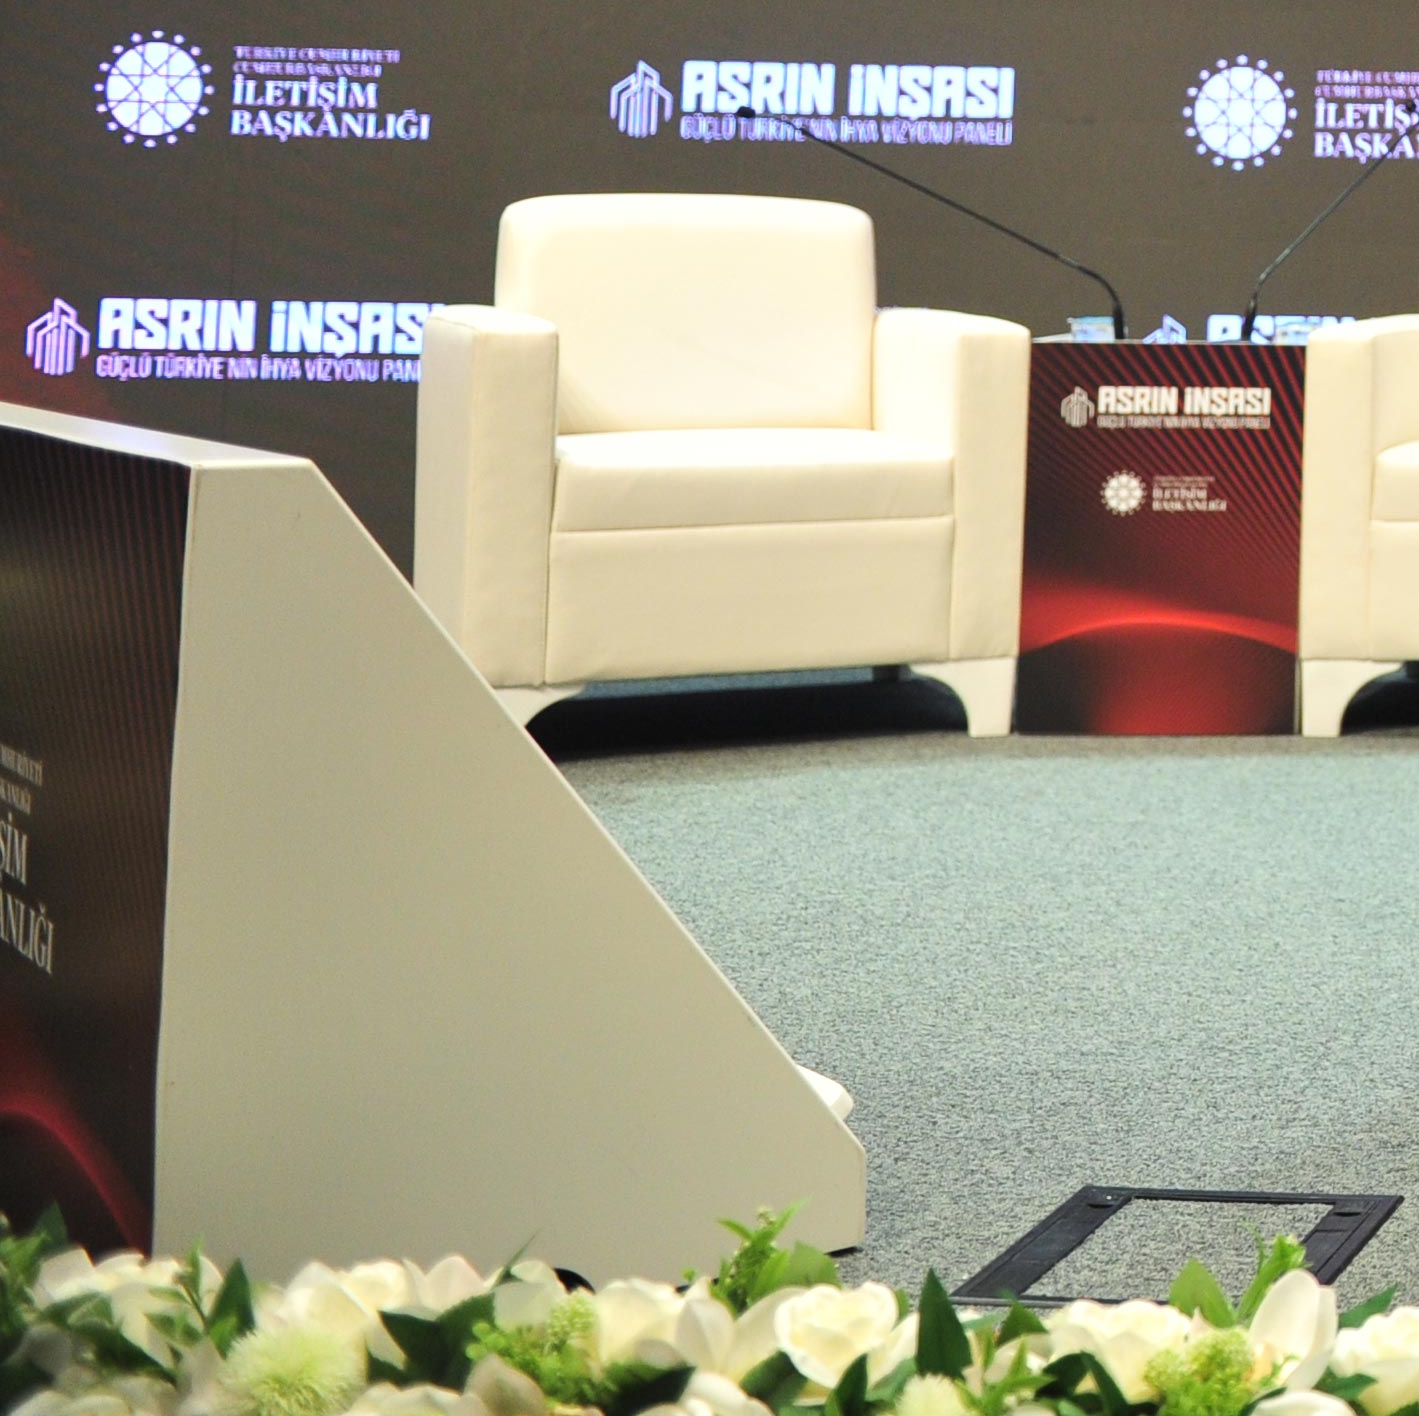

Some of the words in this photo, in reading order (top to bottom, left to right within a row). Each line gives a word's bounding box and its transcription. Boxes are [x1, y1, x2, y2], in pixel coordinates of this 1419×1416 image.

[231, 74, 379, 110] İLETİŞİM
[681, 60, 836, 115] ASRIN
[230, 109, 431, 142] BAŞKANLIĞI
[98, 298, 256, 352] ASRIN
[1098, 385, 1178, 414] ASRIN
